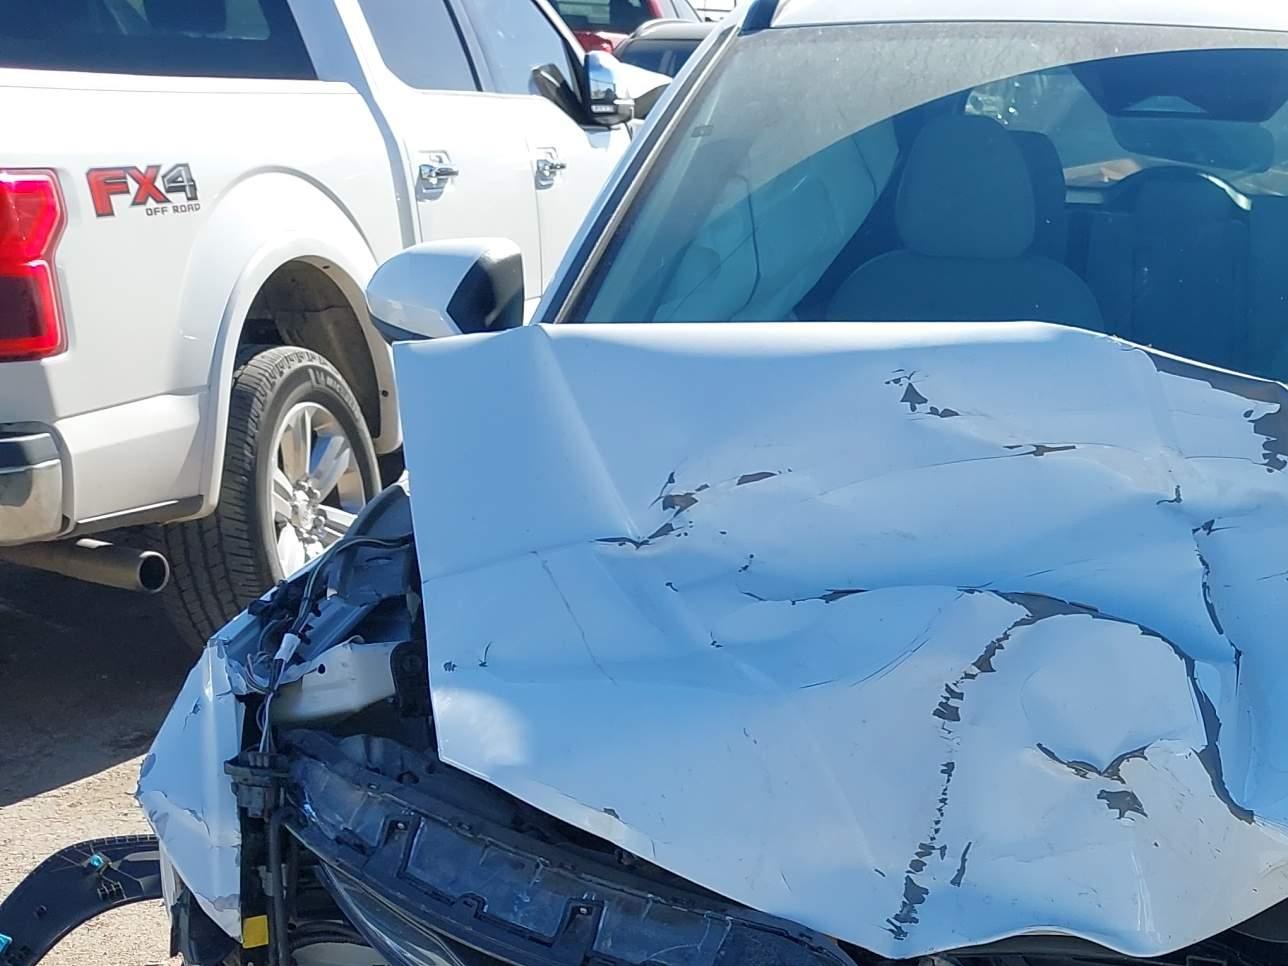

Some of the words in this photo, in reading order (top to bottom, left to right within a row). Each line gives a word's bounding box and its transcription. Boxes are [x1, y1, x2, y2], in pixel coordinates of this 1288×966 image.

[86, 163, 199, 217] FX4
[146, 206, 168, 216] OFF
[172, 203, 201, 214] ROAD
